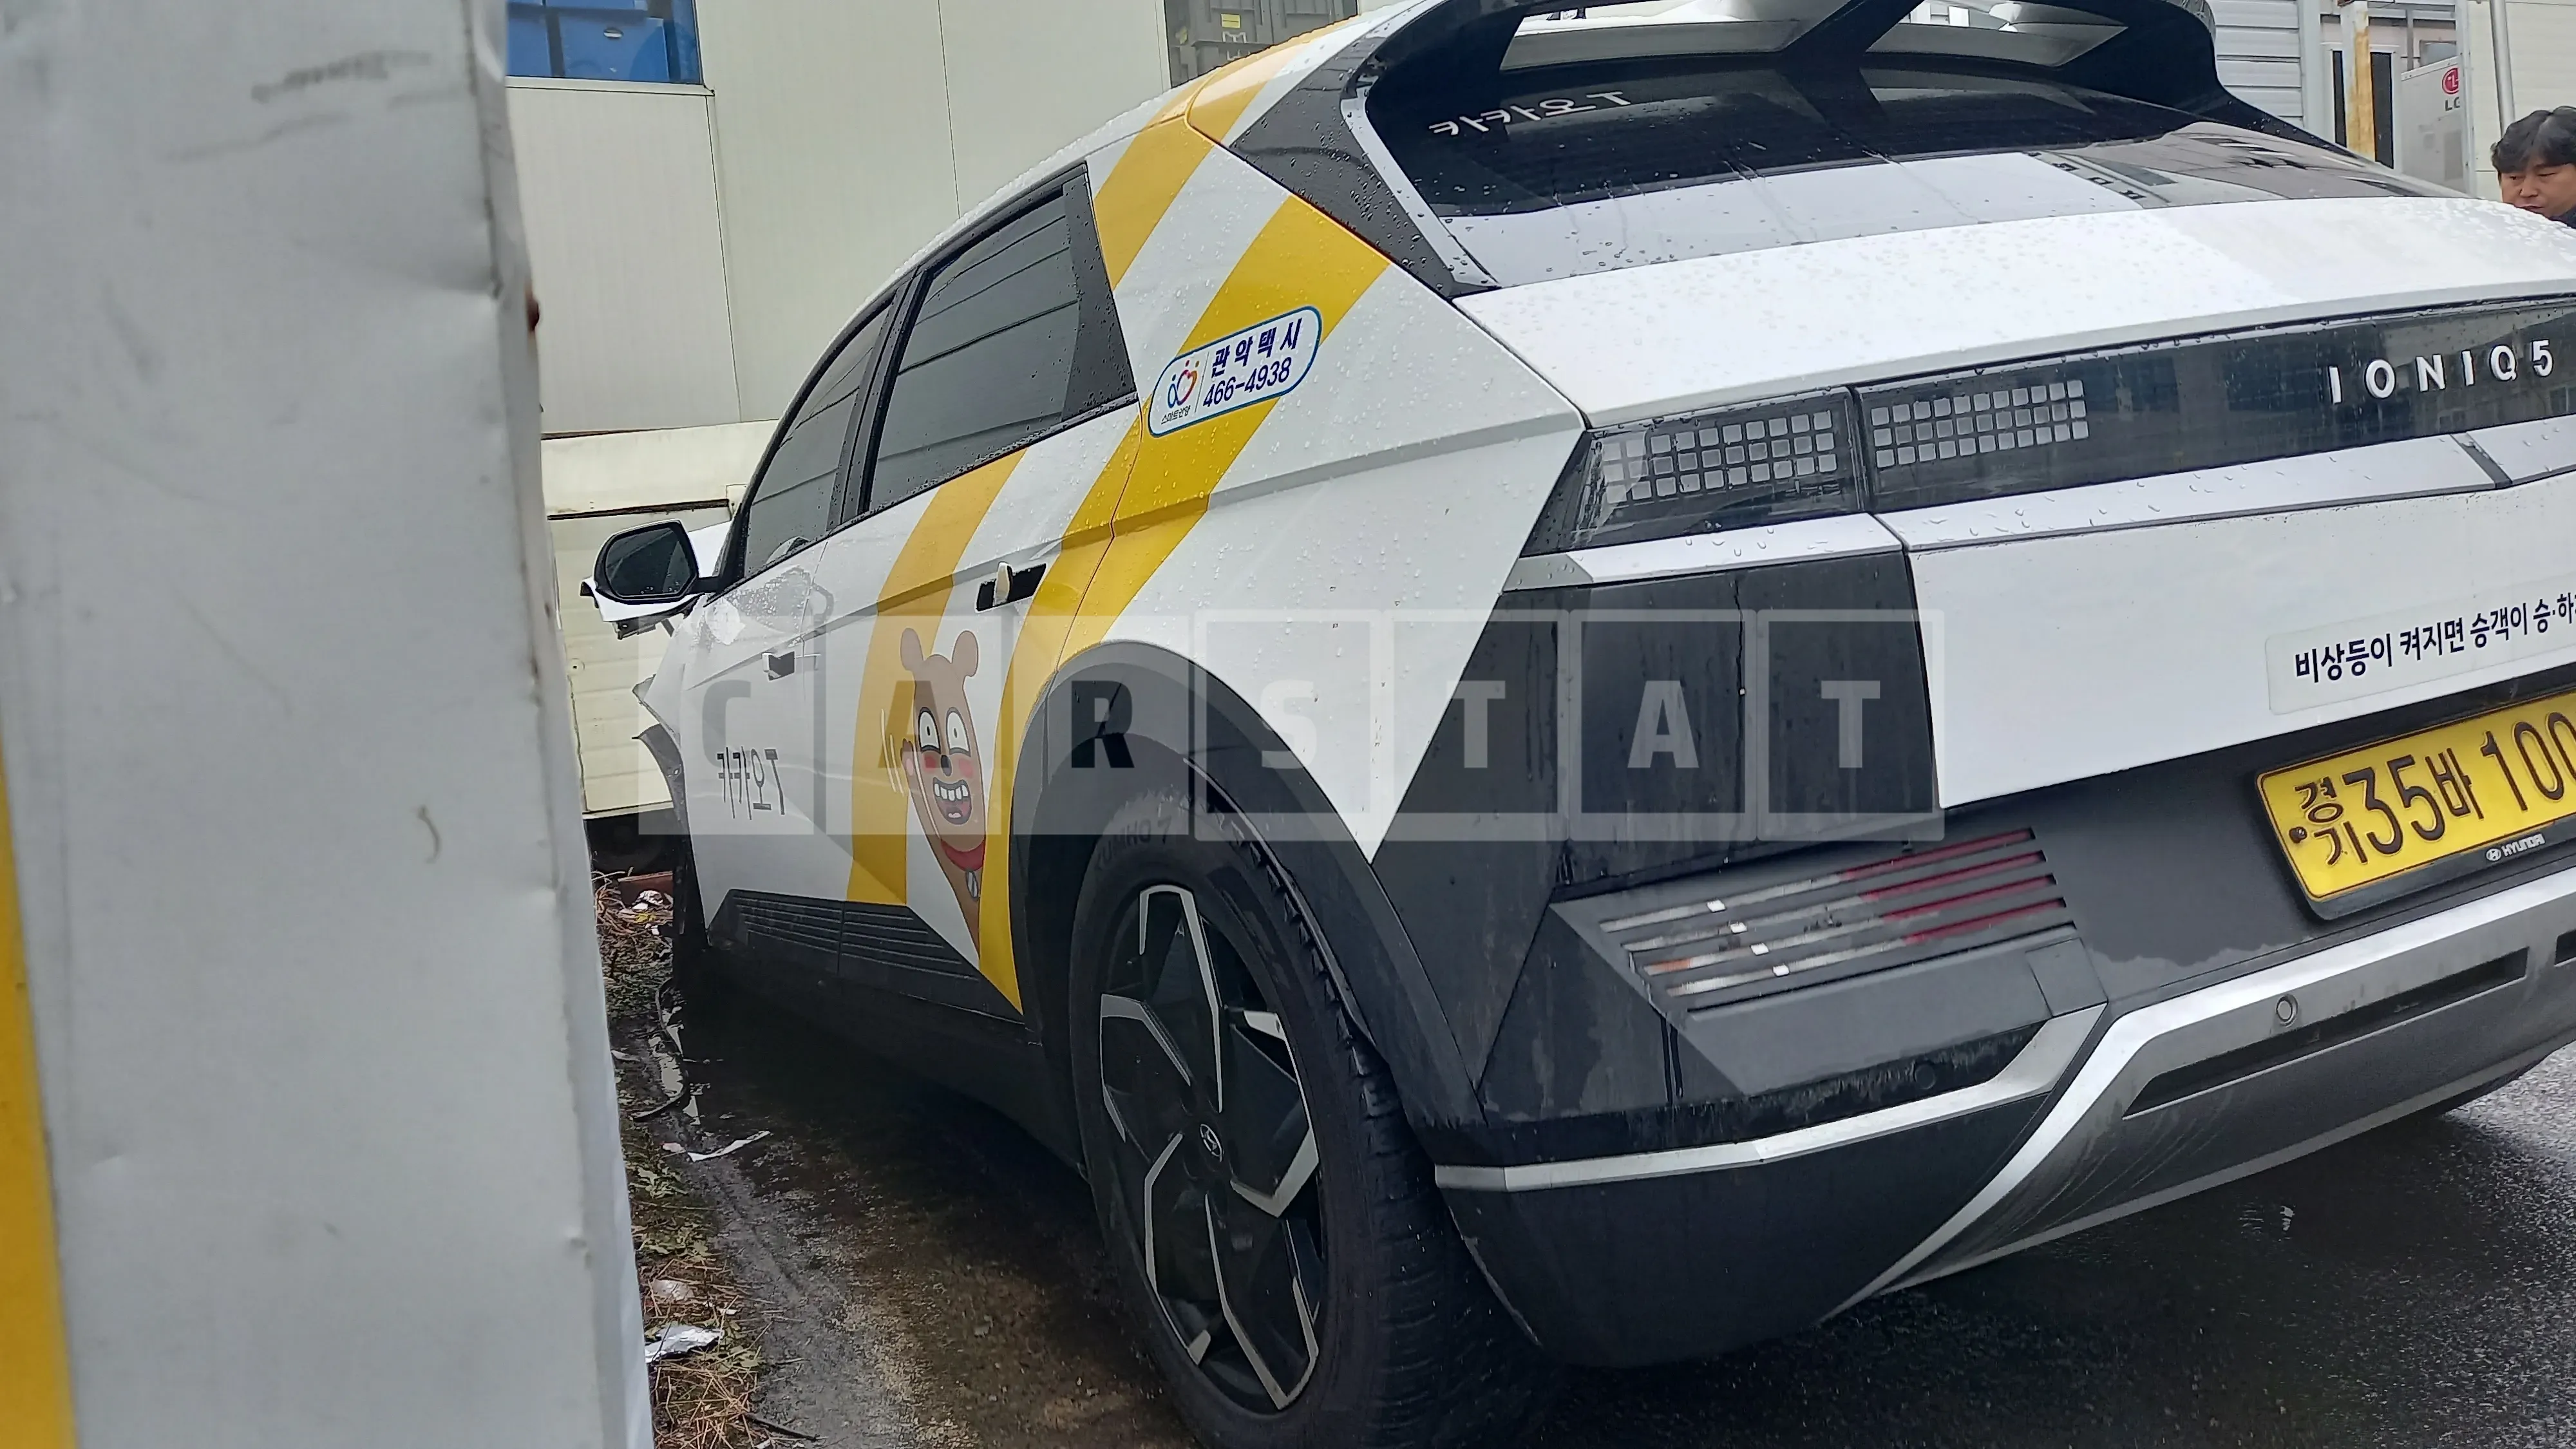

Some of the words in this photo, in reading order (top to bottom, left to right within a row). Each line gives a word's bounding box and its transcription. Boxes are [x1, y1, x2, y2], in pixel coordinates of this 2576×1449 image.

[1202, 357, 1293, 408] 466-4938
[2295, 632, 2392, 683] 비상등이
[2400, 617, 2465, 661] 켜지면
[2470, 602, 2528, 648] 승객이
[2532, 592, 2576, 634] 승·하
[2501, 833, 2545, 856] HYUNDAI
